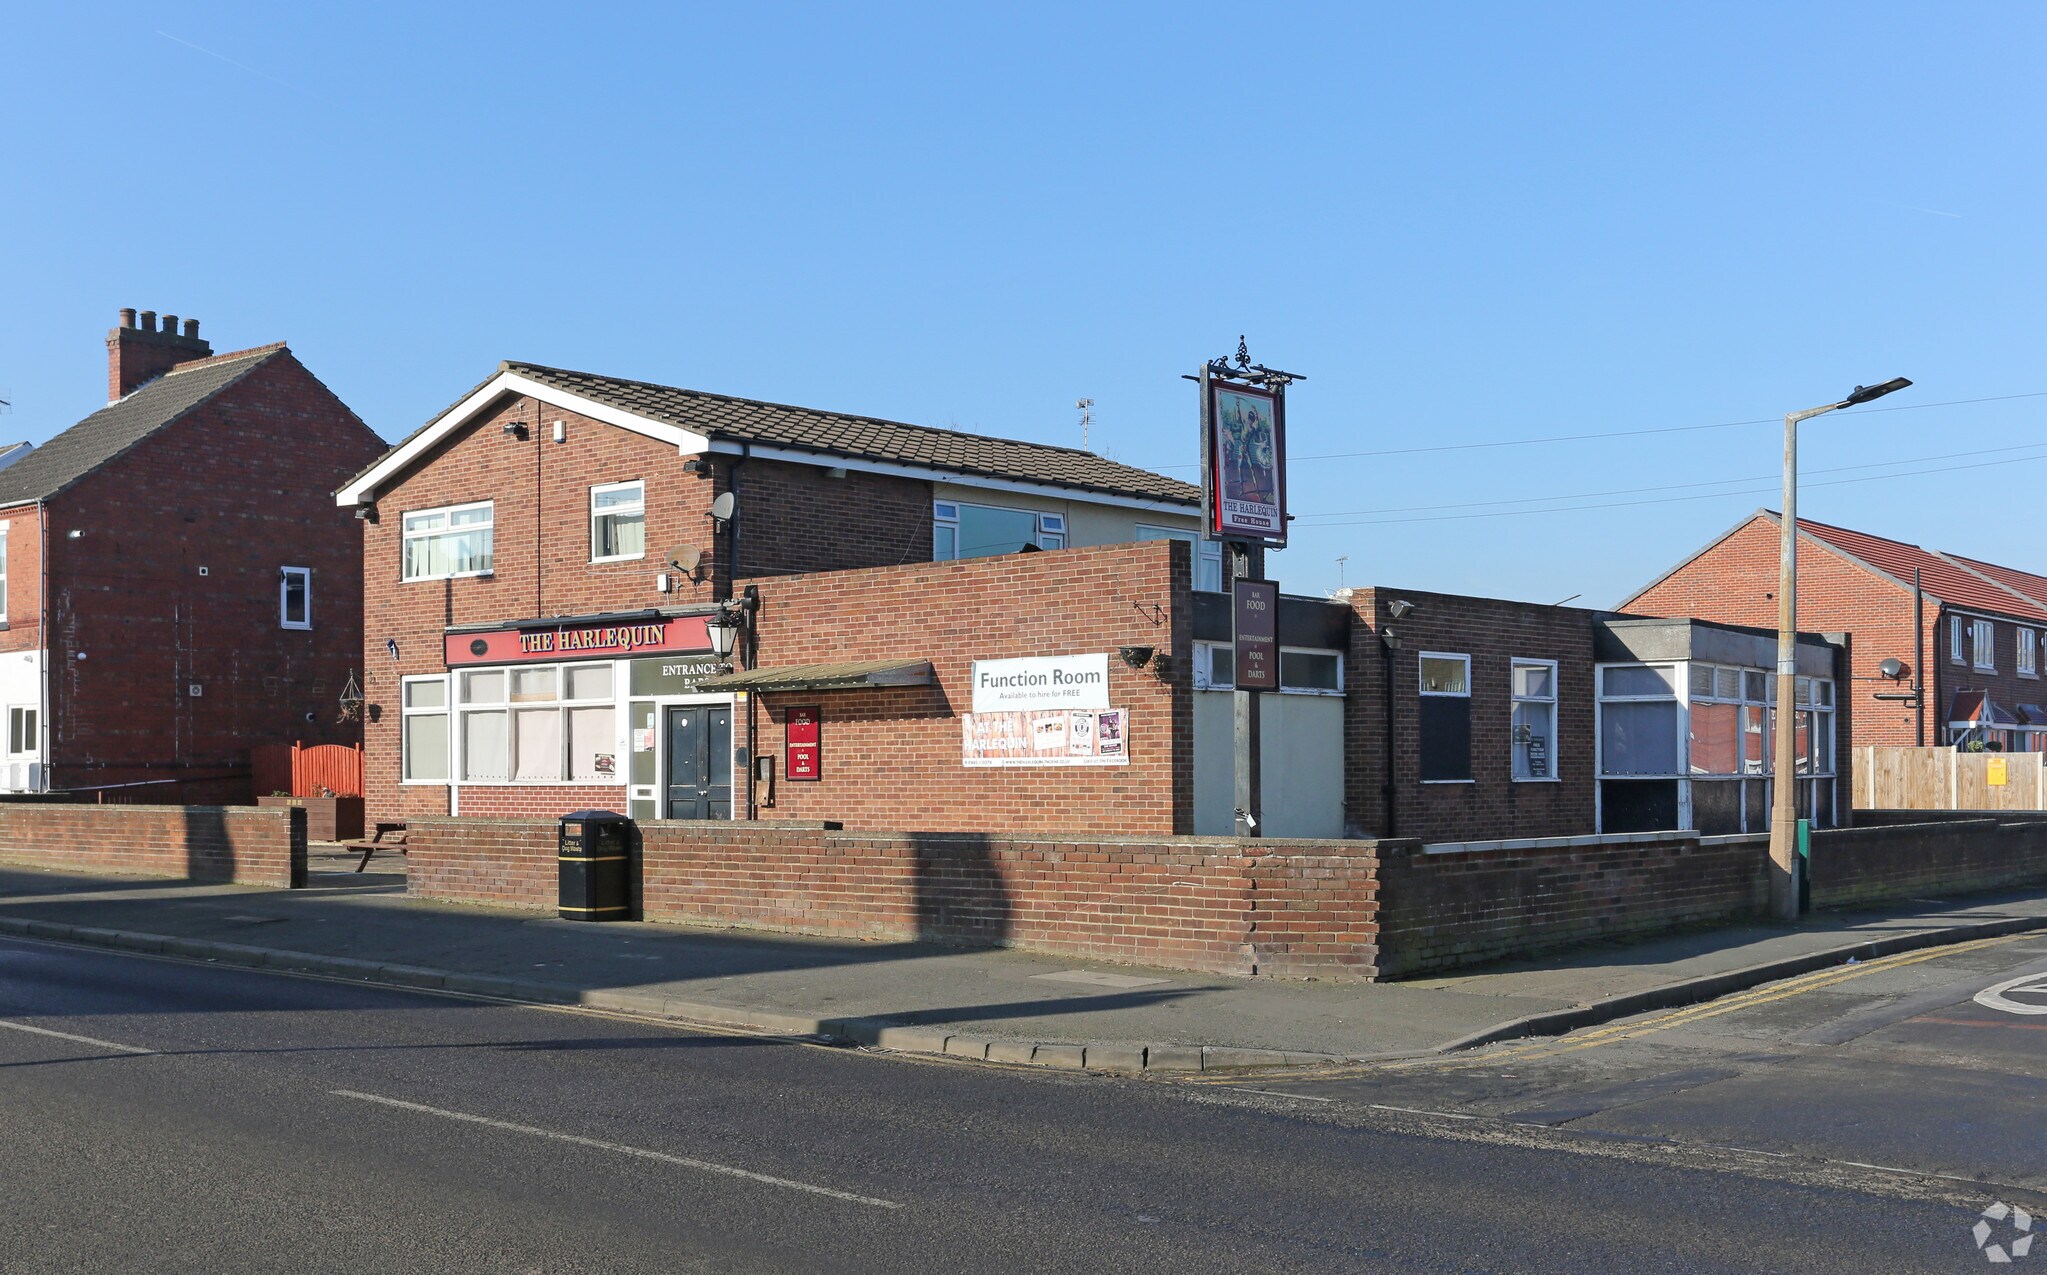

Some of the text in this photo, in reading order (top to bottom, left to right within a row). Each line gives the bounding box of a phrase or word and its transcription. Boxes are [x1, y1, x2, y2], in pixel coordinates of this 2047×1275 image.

[1223, 501, 1278, 517] THE HARLEQUIN
[1233, 515, 1270, 527] Free House
[1246, 600, 1266, 611] FOOD
[519, 624, 666, 653] THE HARLEQUIN
[1239, 634, 1273, 643] ENTERTAINMENT
[1249, 651, 1264, 660] POOL
[662, 663, 717, 676] ENTRANCE
[1248, 670, 1265, 679] DARTS
[684, 677, 710, 689] BA
[981, 668, 1101, 689] Function Room
[999, 688, 1081, 700] Available to hire for FREE
[795, 718, 811, 726] FOOD
[977, 720, 1013, 734] AT THE
[964, 737, 1027, 750] HARLEQUIN
